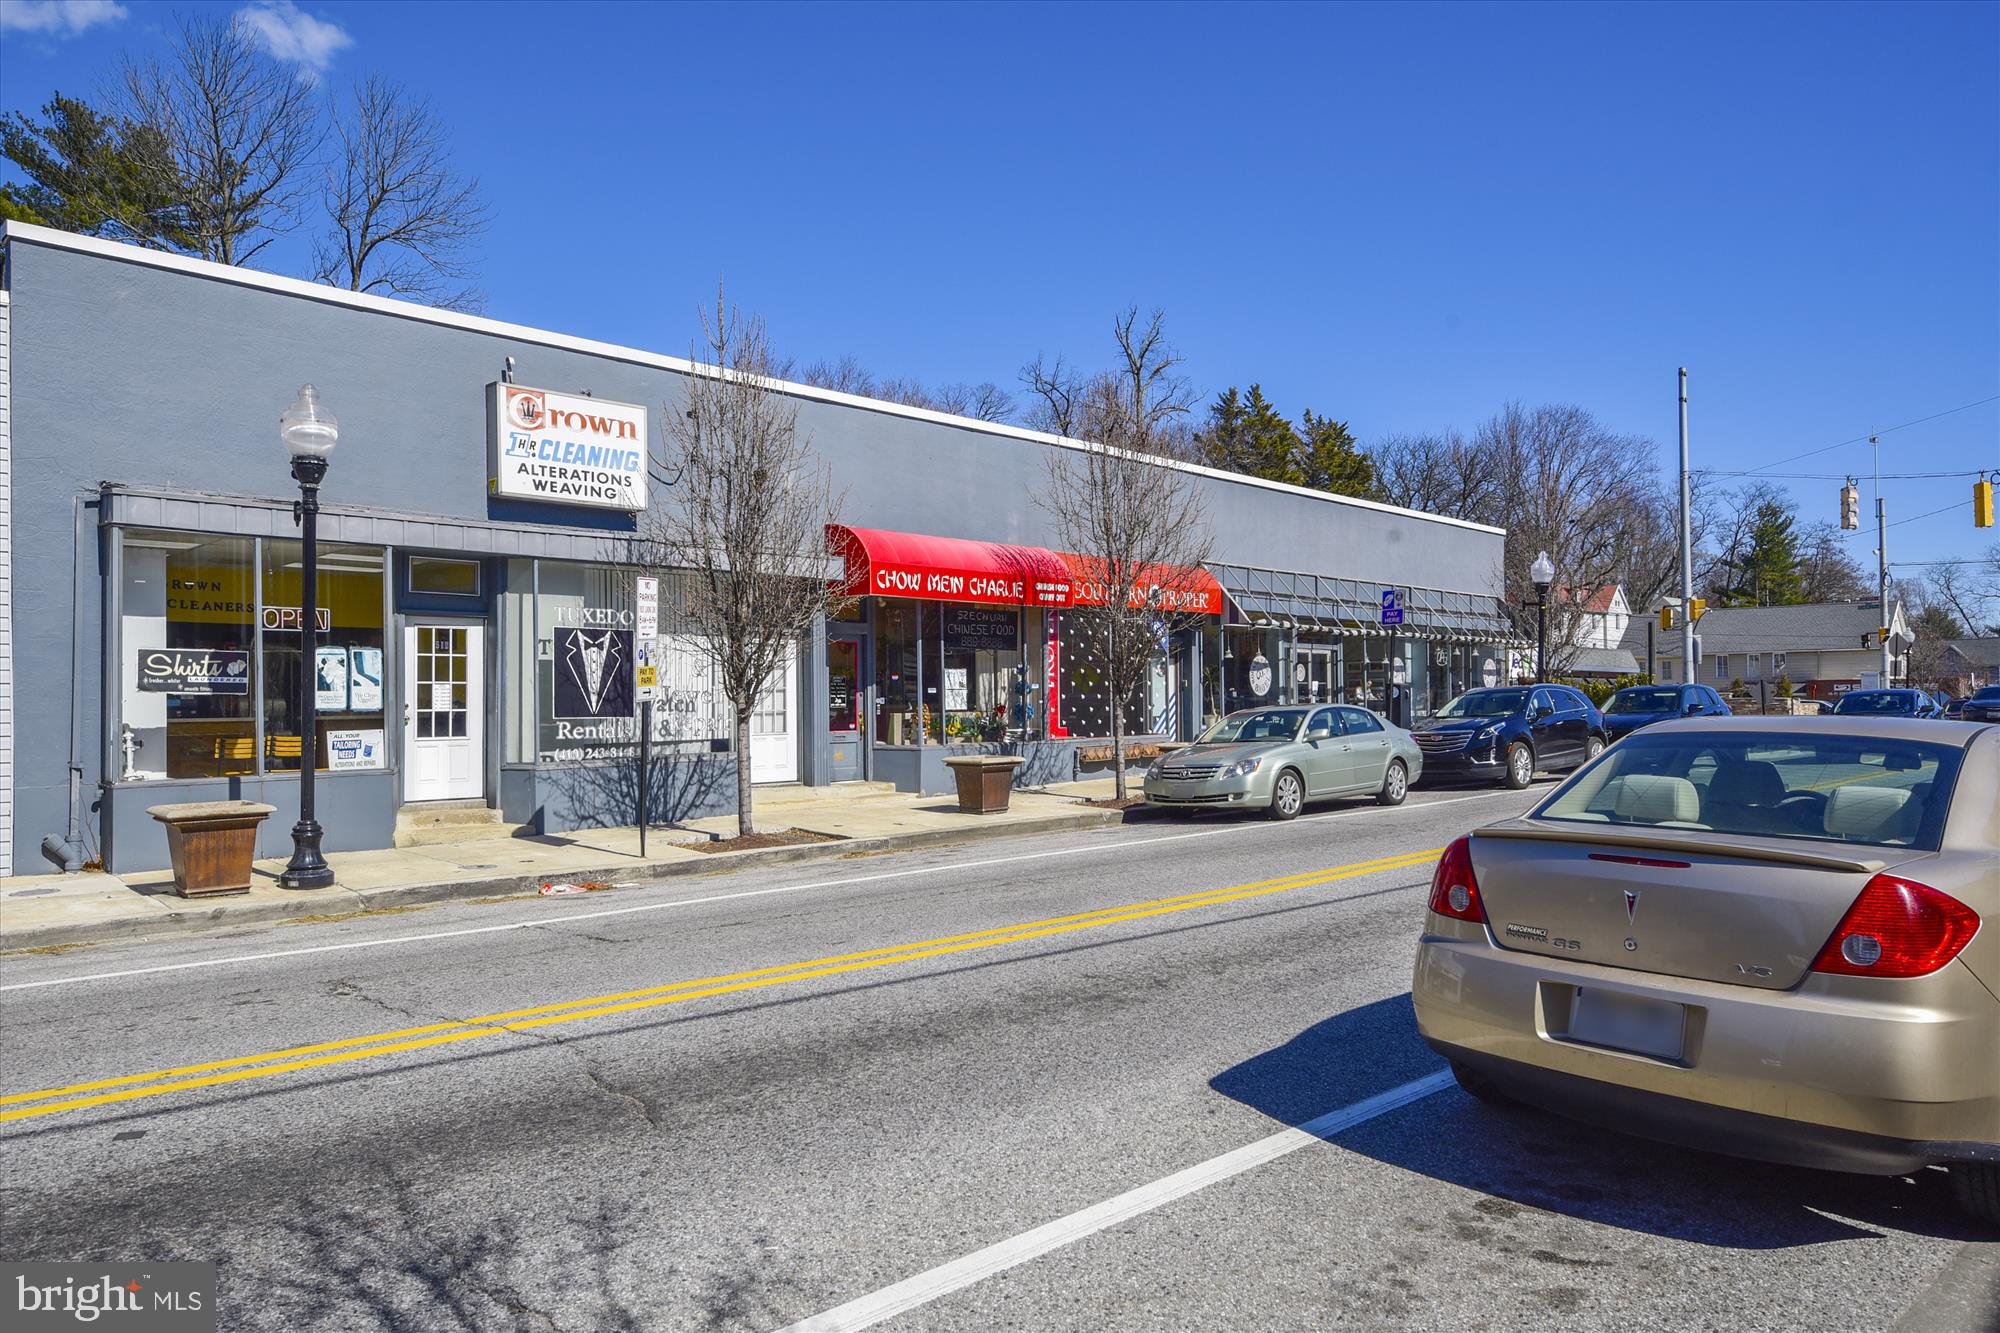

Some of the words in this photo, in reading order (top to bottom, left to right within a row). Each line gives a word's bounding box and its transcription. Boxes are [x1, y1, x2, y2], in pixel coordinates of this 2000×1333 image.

[506, 388, 640, 440] Crown
[537, 438, 640, 472] CLEANING
[517, 462, 632, 487] ALTERATIONS
[532, 478, 617, 499] WEAVING
[876, 569, 921, 591] CHOW
[927, 573, 964, 594] MEIN
[969, 577, 1024, 599] CHARLIE
[167, 598, 255, 613] CLEANERS
[554, 605, 635, 626] TUXEDO
[947, 623, 989, 636] CHINESE
[144, 653, 223, 677] Shirts
[556, 720, 632, 740] Rentals
[1507, 924, 1548, 937] PERFORMANCE
